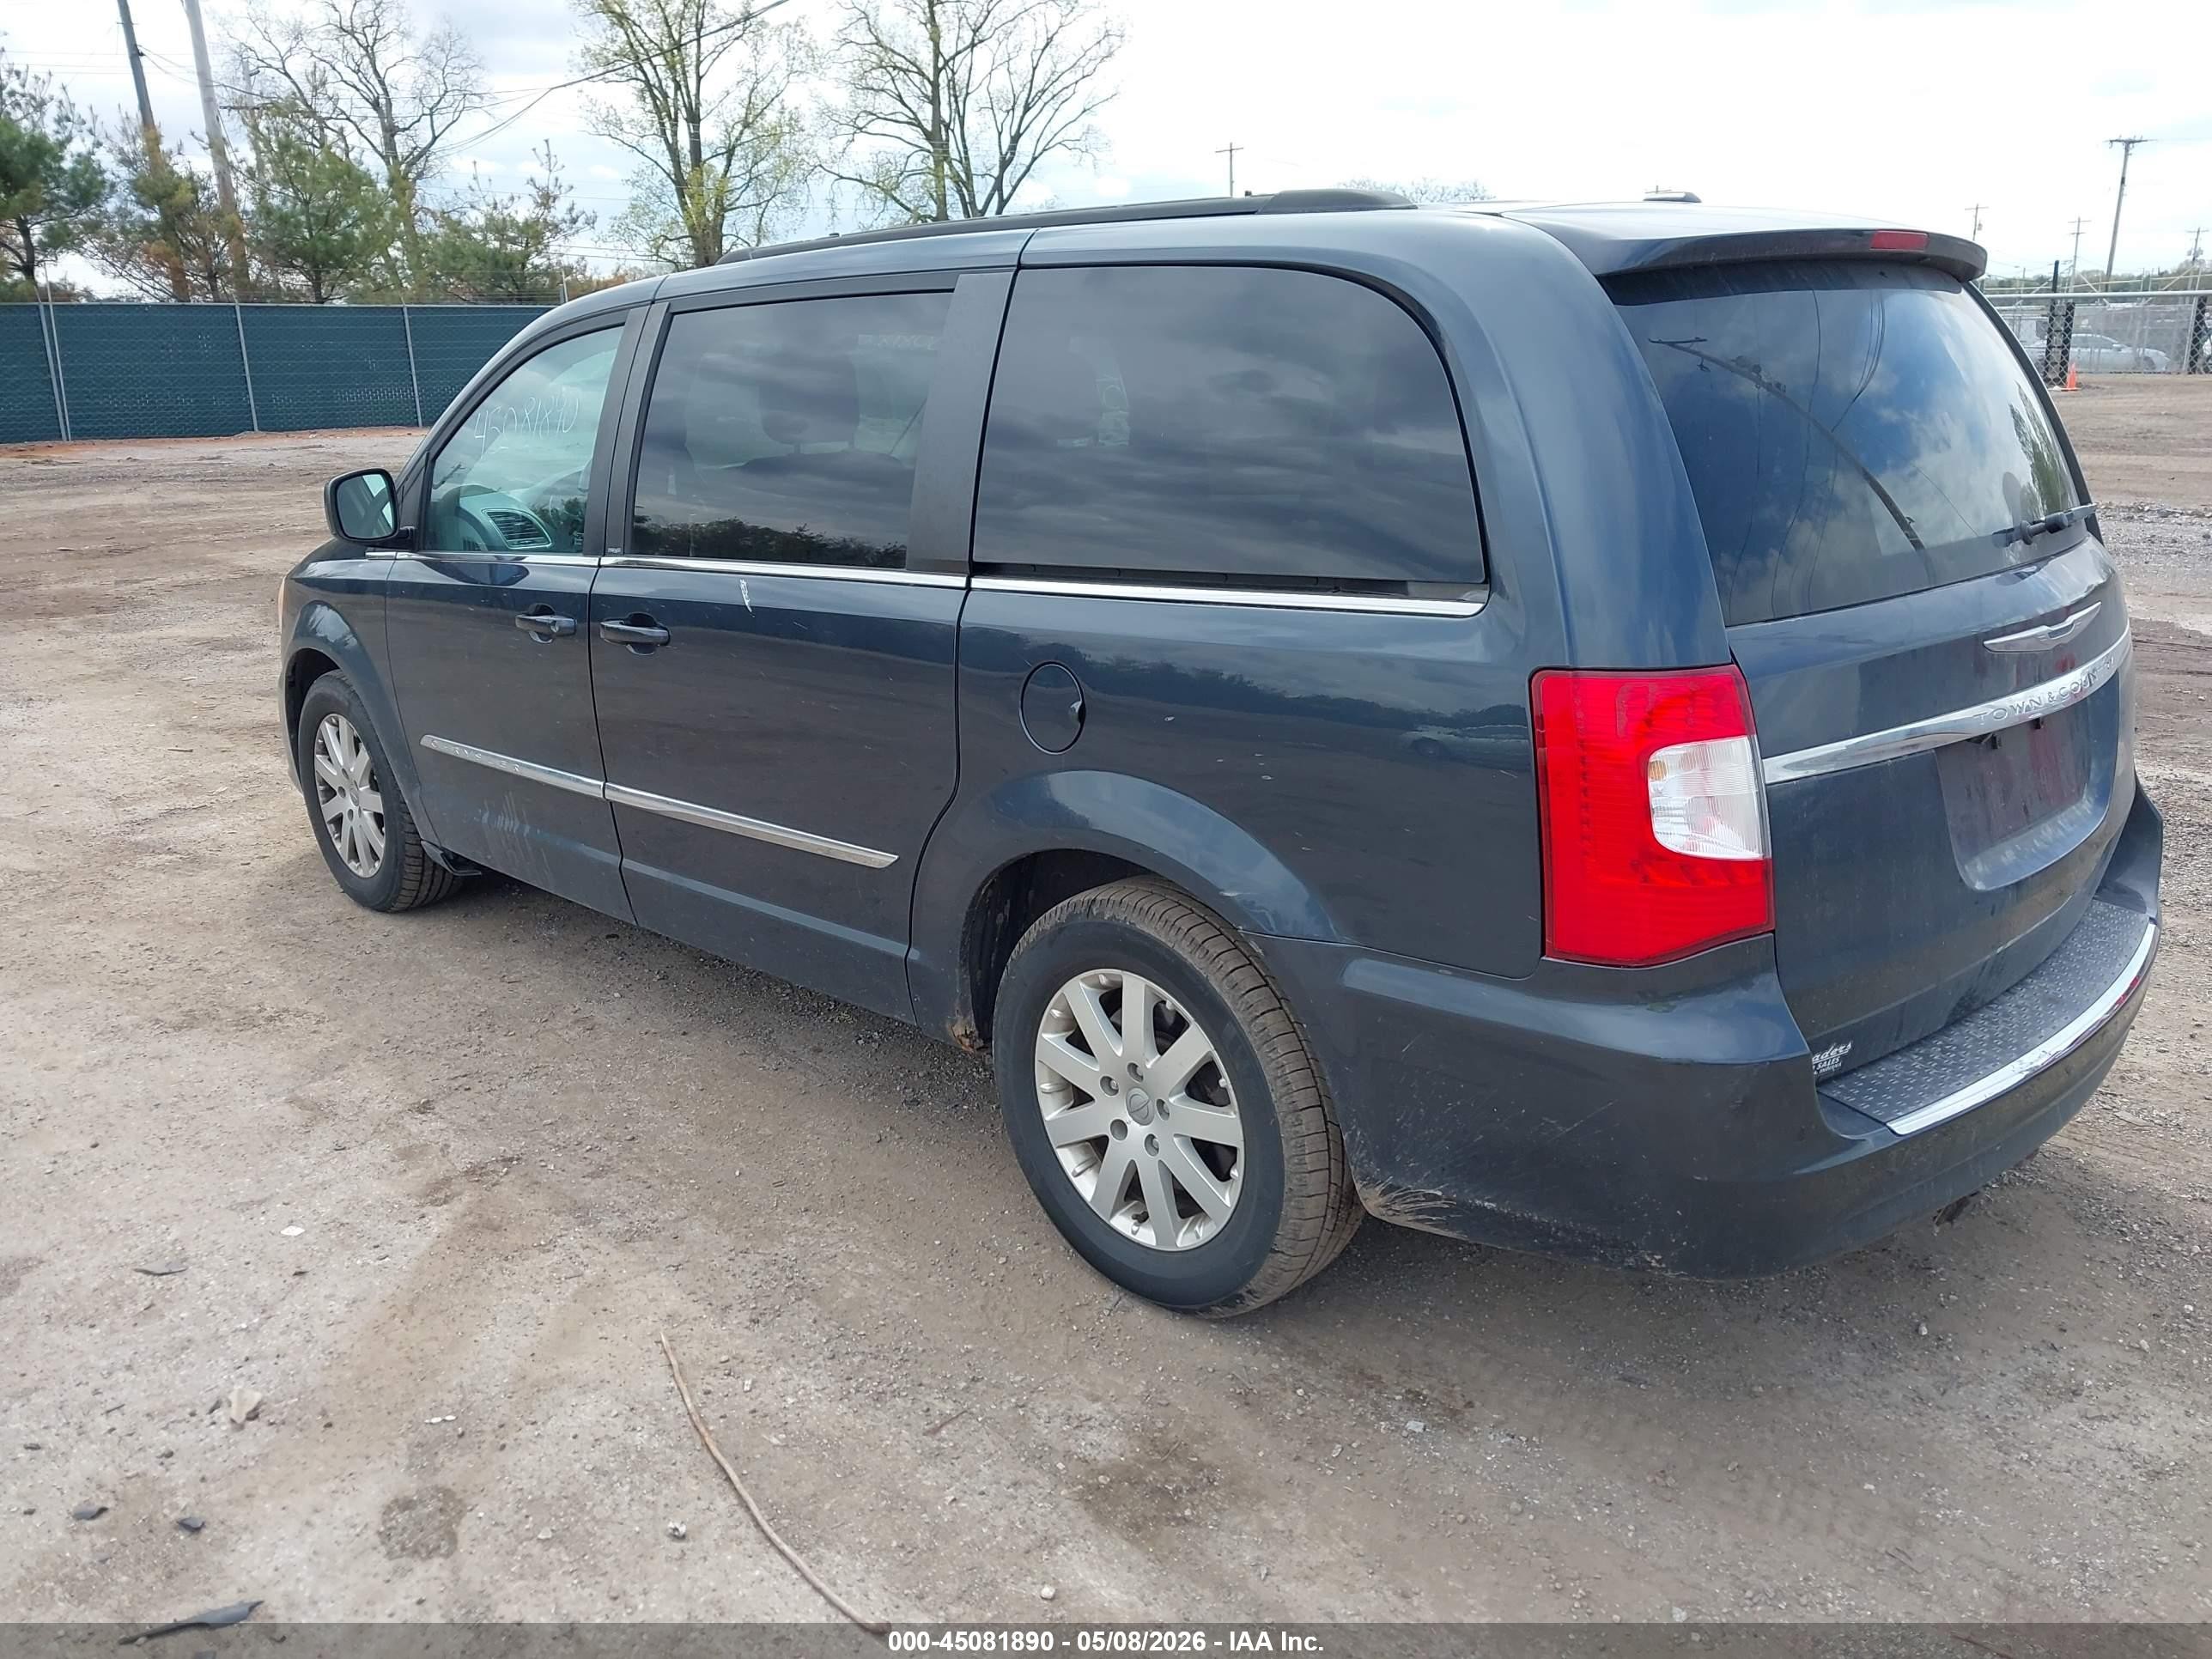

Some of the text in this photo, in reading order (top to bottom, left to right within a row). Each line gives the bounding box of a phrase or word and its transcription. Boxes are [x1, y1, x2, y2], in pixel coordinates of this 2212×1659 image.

[474, 392, 580, 454] 45081890
[1974, 696, 2042, 725] TOWN
[2047, 691, 2057, 704] &
[430, 738, 520, 772] CRYSER
[1816, 1056, 1841, 1071] SALES
